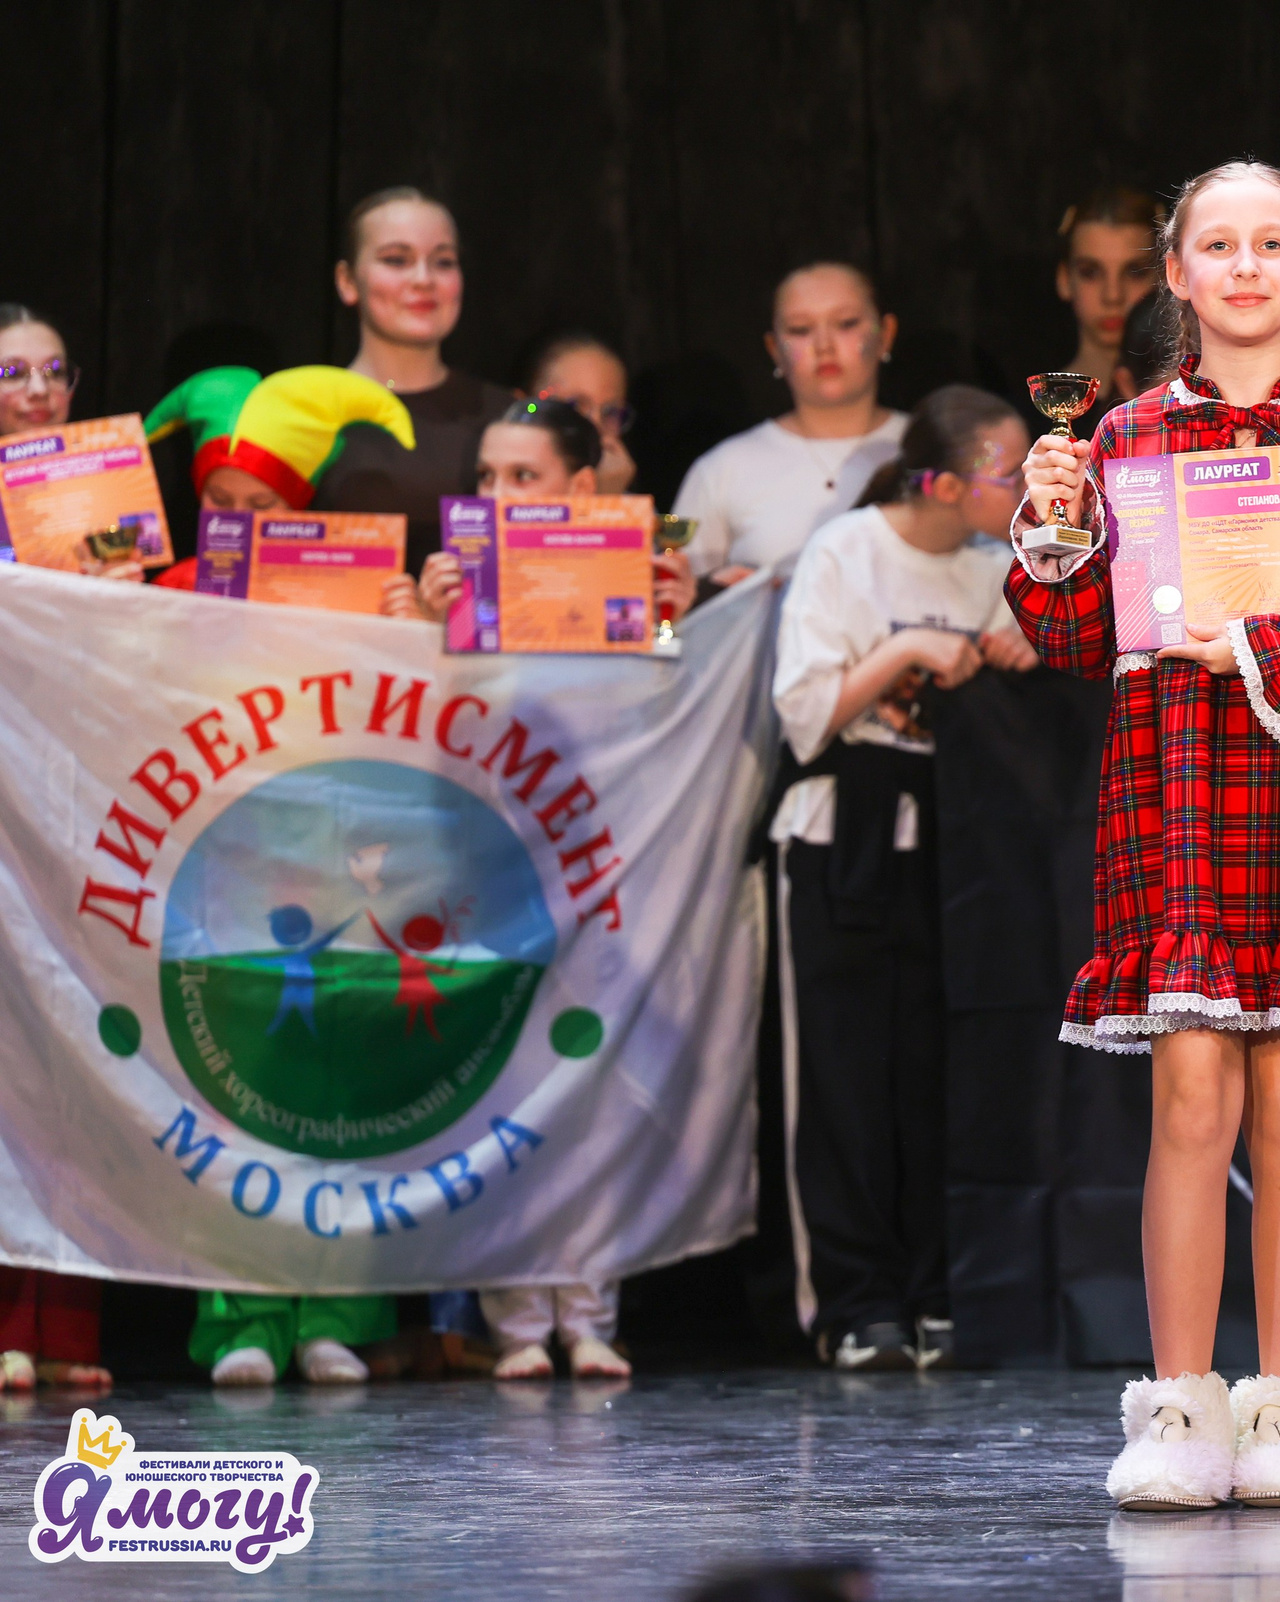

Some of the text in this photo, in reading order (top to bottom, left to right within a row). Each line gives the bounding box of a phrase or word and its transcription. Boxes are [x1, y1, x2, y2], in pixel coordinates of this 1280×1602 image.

[1193, 462, 1260, 481] ЛАУРЕАТ
[1212, 527, 1240, 535] Самарская
[1242, 524, 1263, 532] область
[1228, 517, 1258, 525] «Гармония
[178, 960, 233, 1075] Детский
[218, 1070, 456, 1148] хореографический
[153, 1105, 545, 1240] МОСКВА
